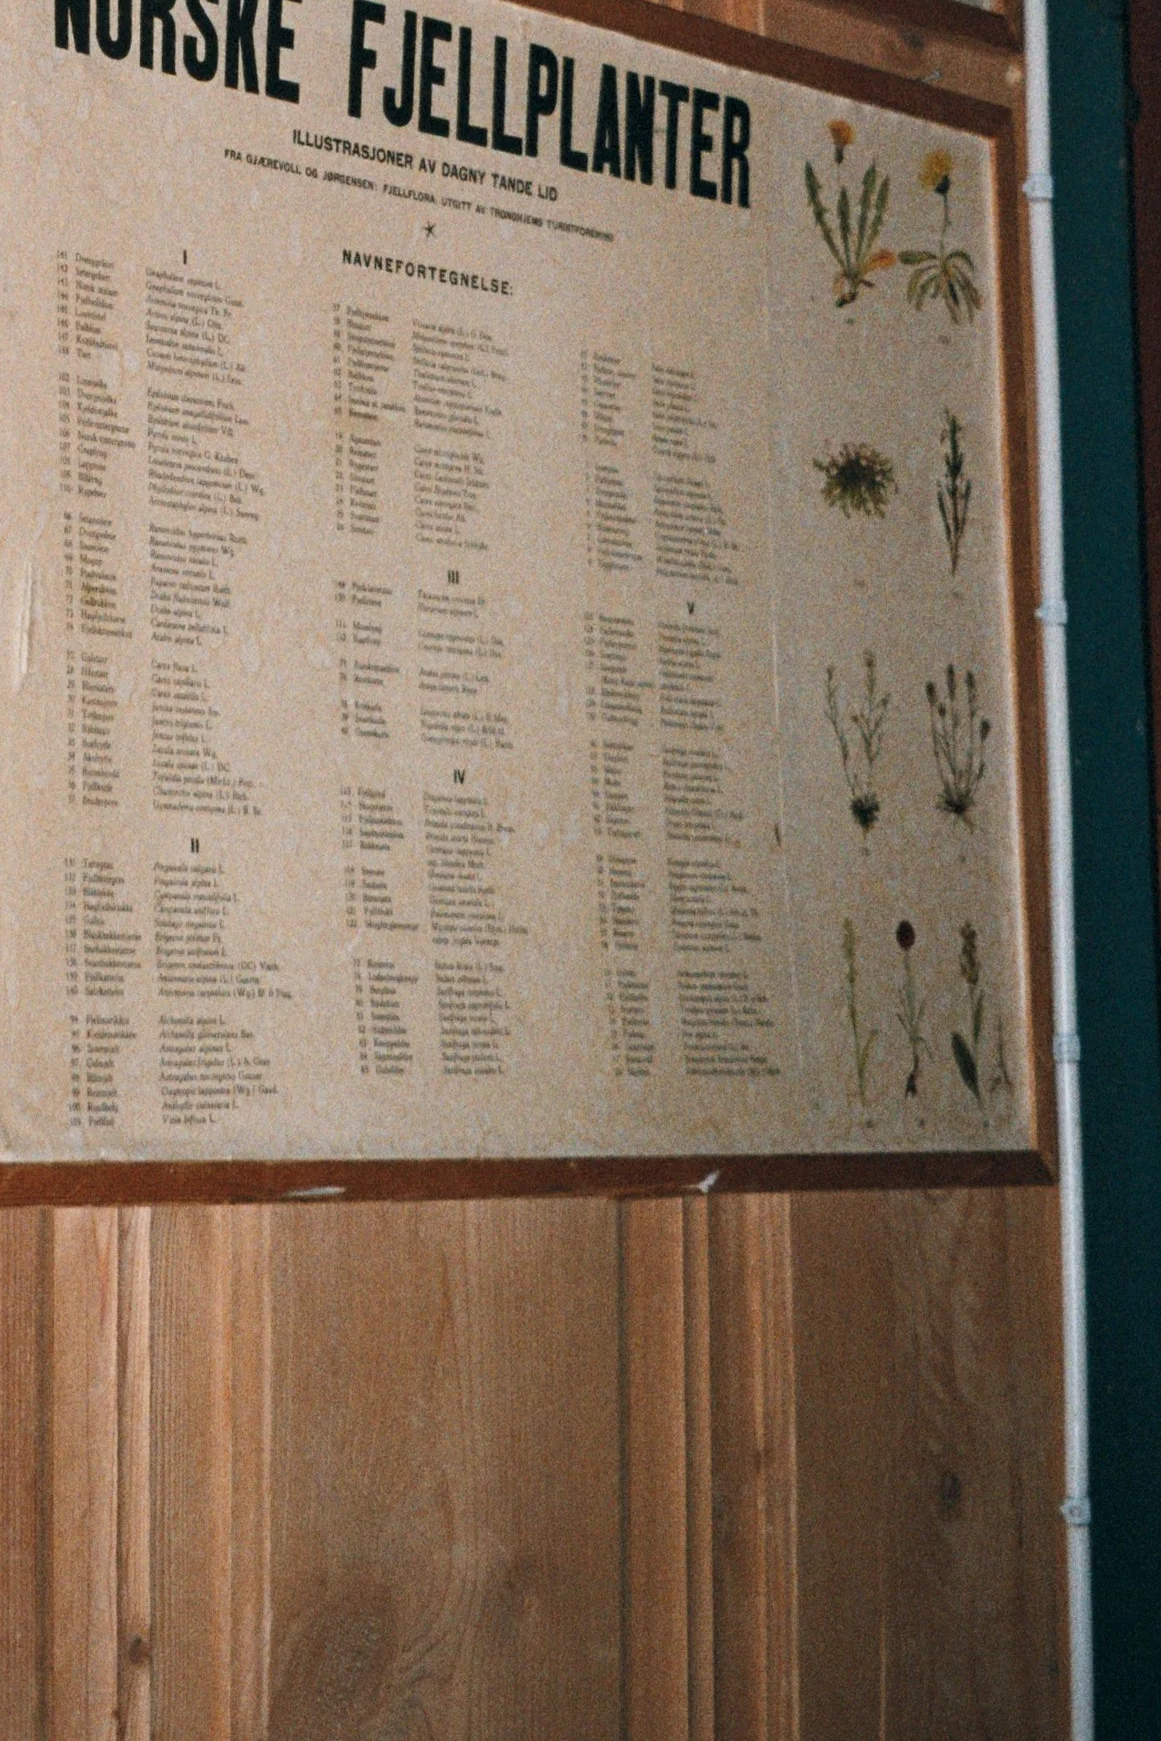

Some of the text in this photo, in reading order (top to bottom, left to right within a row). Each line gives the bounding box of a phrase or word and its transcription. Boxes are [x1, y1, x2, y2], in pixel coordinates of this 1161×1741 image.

[224, 149, 242, 161] FRA
[305, 167, 318, 179] OG
[441, 197, 471, 211] UTGITT
[292, 129, 559, 202] ILLUSTRASJONER AV DAGNY TANDE LID
[342, 248, 514, 296] NAVNEFORTEGNELSE:
[453, 768, 466, 785] IV
